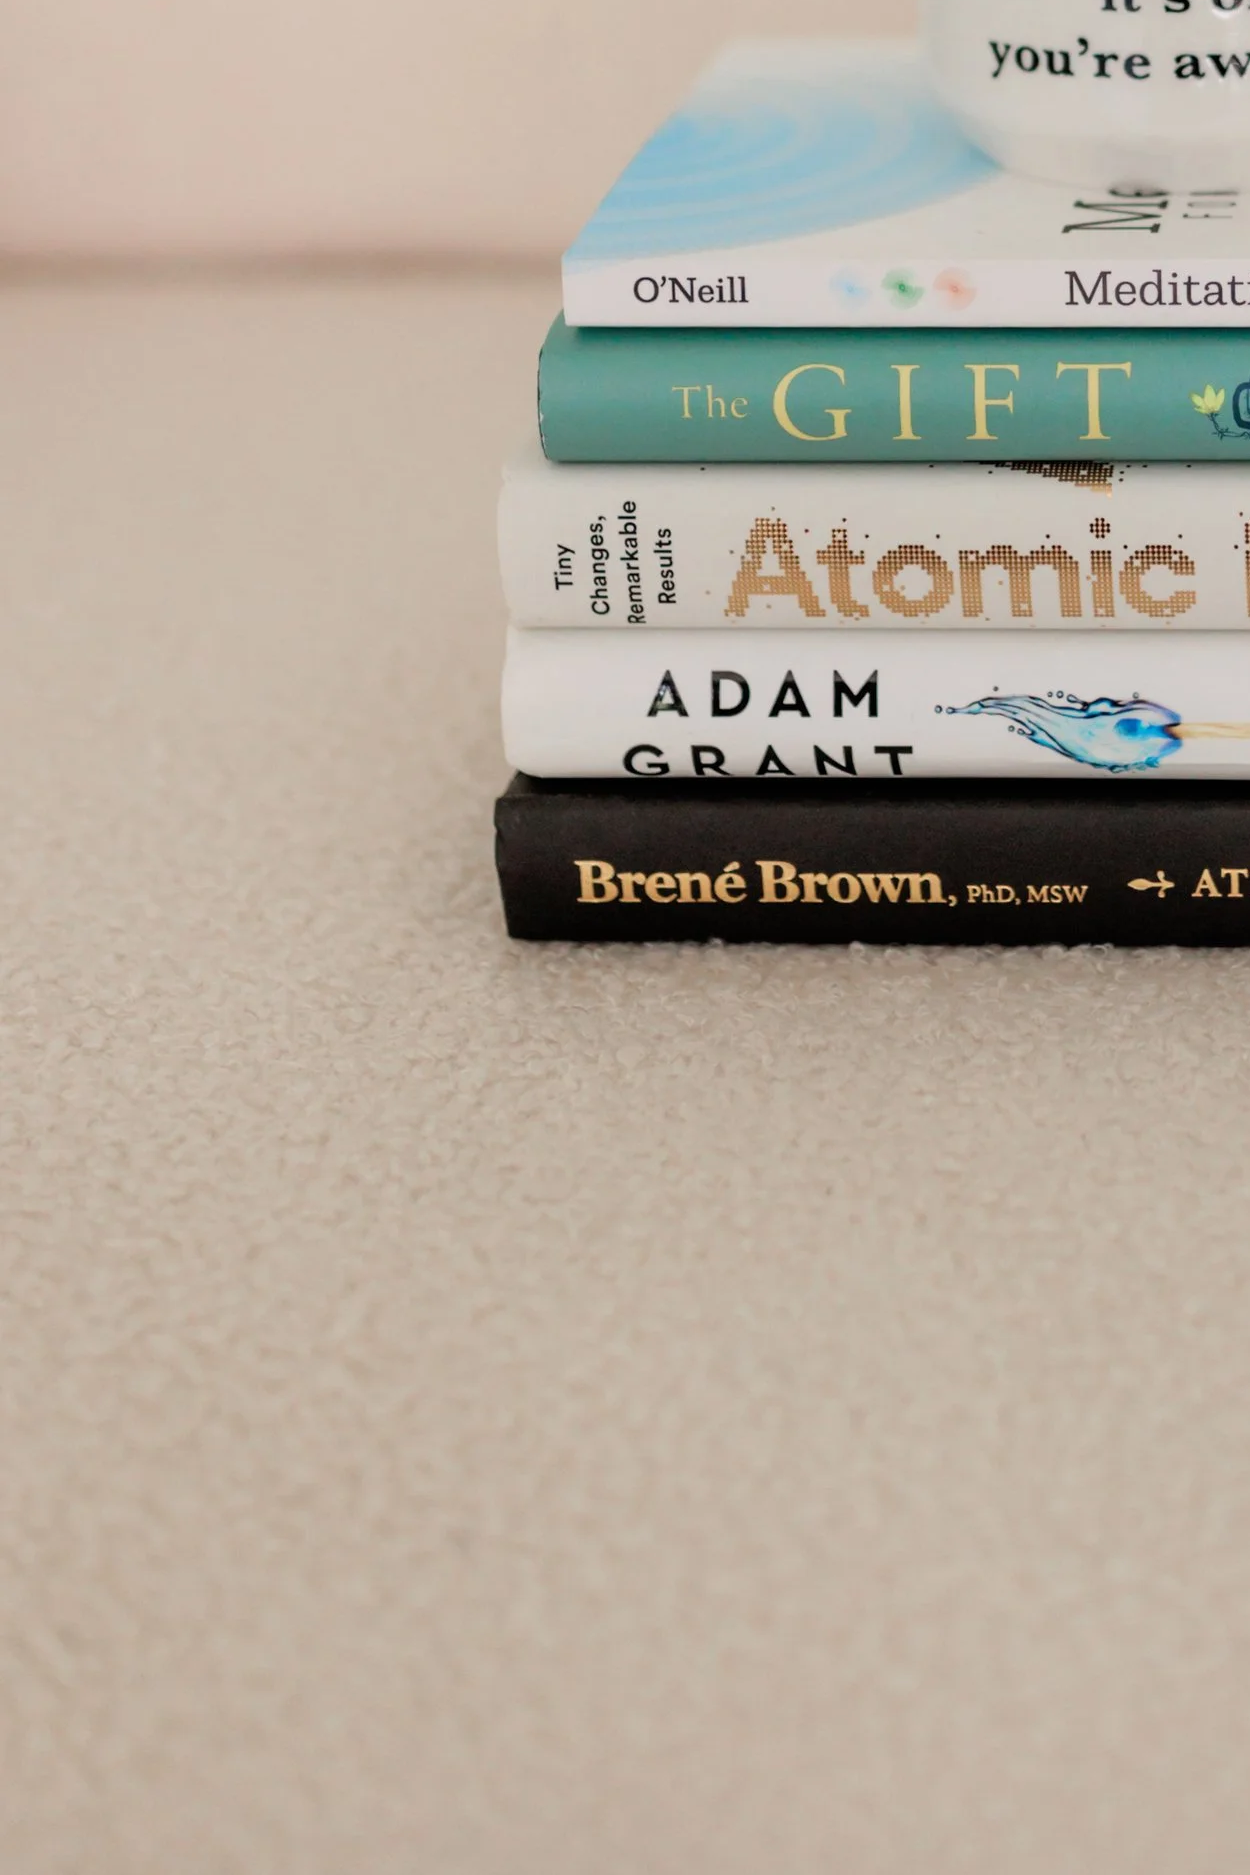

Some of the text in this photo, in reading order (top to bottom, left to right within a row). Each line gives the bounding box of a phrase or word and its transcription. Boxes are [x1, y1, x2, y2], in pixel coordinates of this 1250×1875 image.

[990, 38, 1150, 79] you’re
[634, 276, 748, 303] O’Neill
[672, 362, 1132, 441] The GIFT
[554, 544, 575, 590] Tiny
[590, 516, 610, 615] Changes,
[618, 501, 646, 623] Remarkable
[654, 529, 676, 603] Results
[723, 516, 1195, 617] Atomic
[648, 670, 878, 717] ADAM
[623, 745, 912, 776] GRANT
[574, 860, 1088, 906] Brené Brown, PhD, MSW
